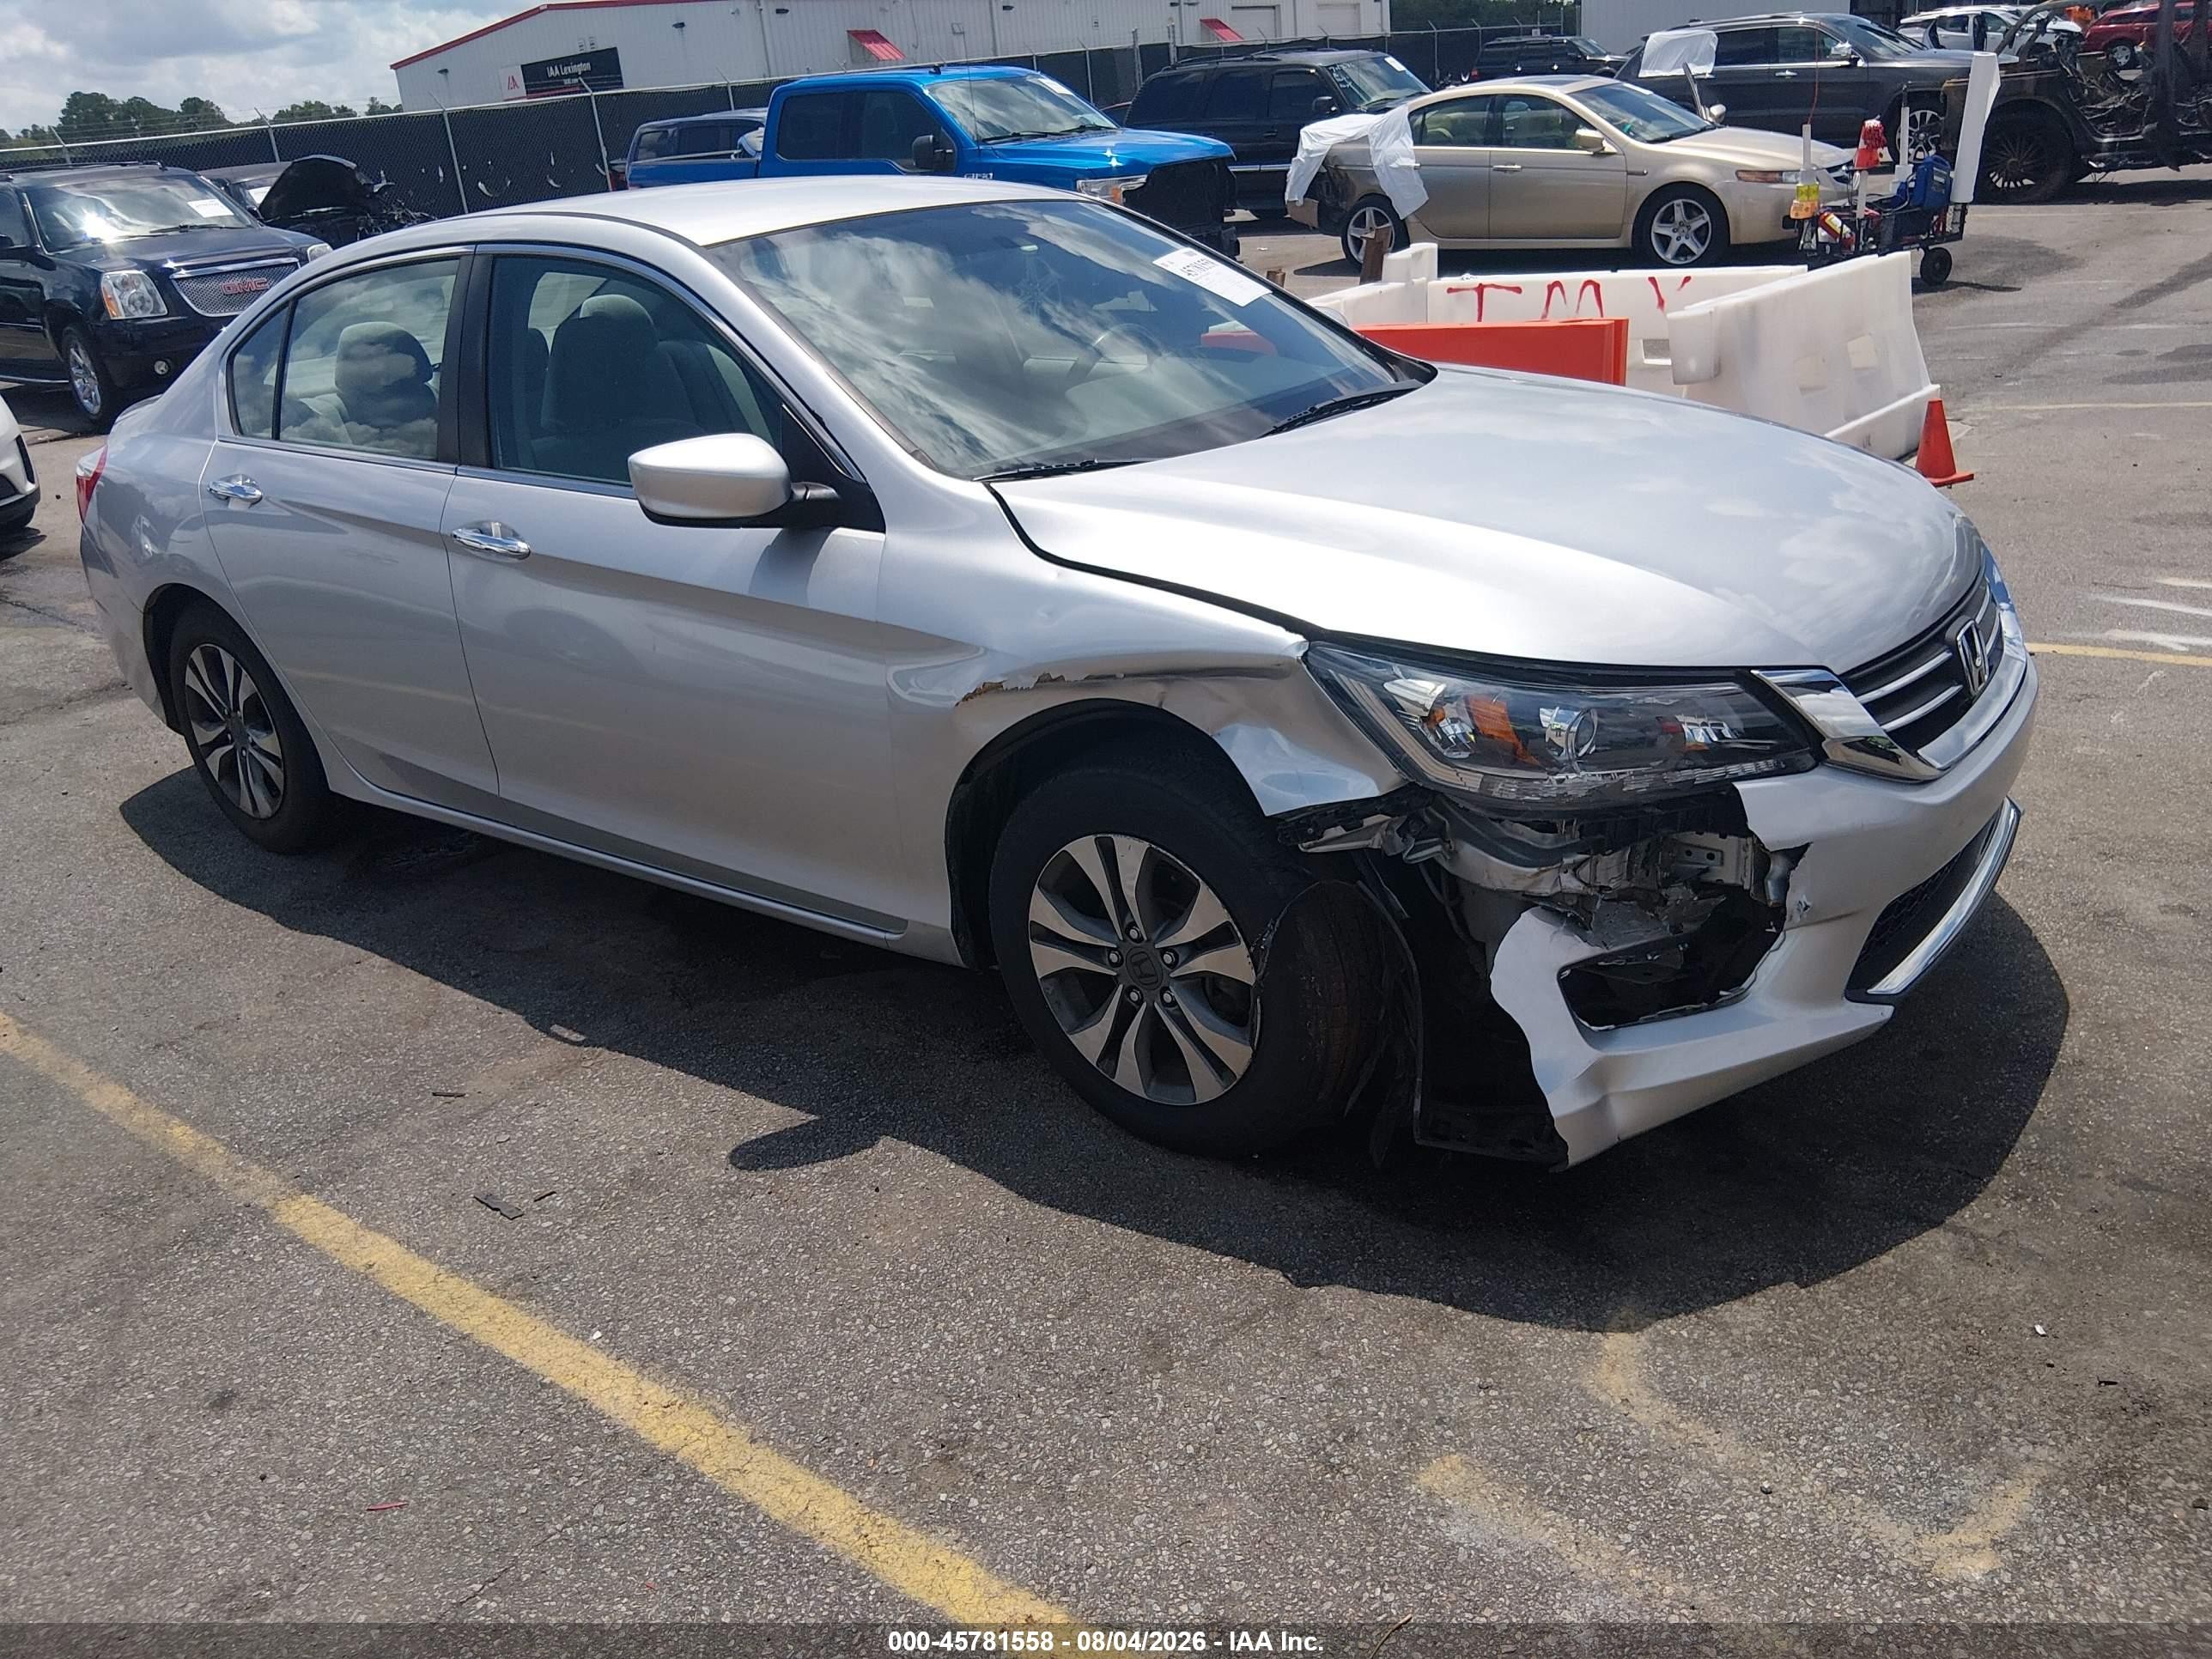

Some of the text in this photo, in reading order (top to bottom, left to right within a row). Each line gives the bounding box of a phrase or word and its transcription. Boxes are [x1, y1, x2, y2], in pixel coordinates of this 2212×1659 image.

[546, 62, 592, 78] IAA Lexington
[222, 279, 269, 295] GMC
